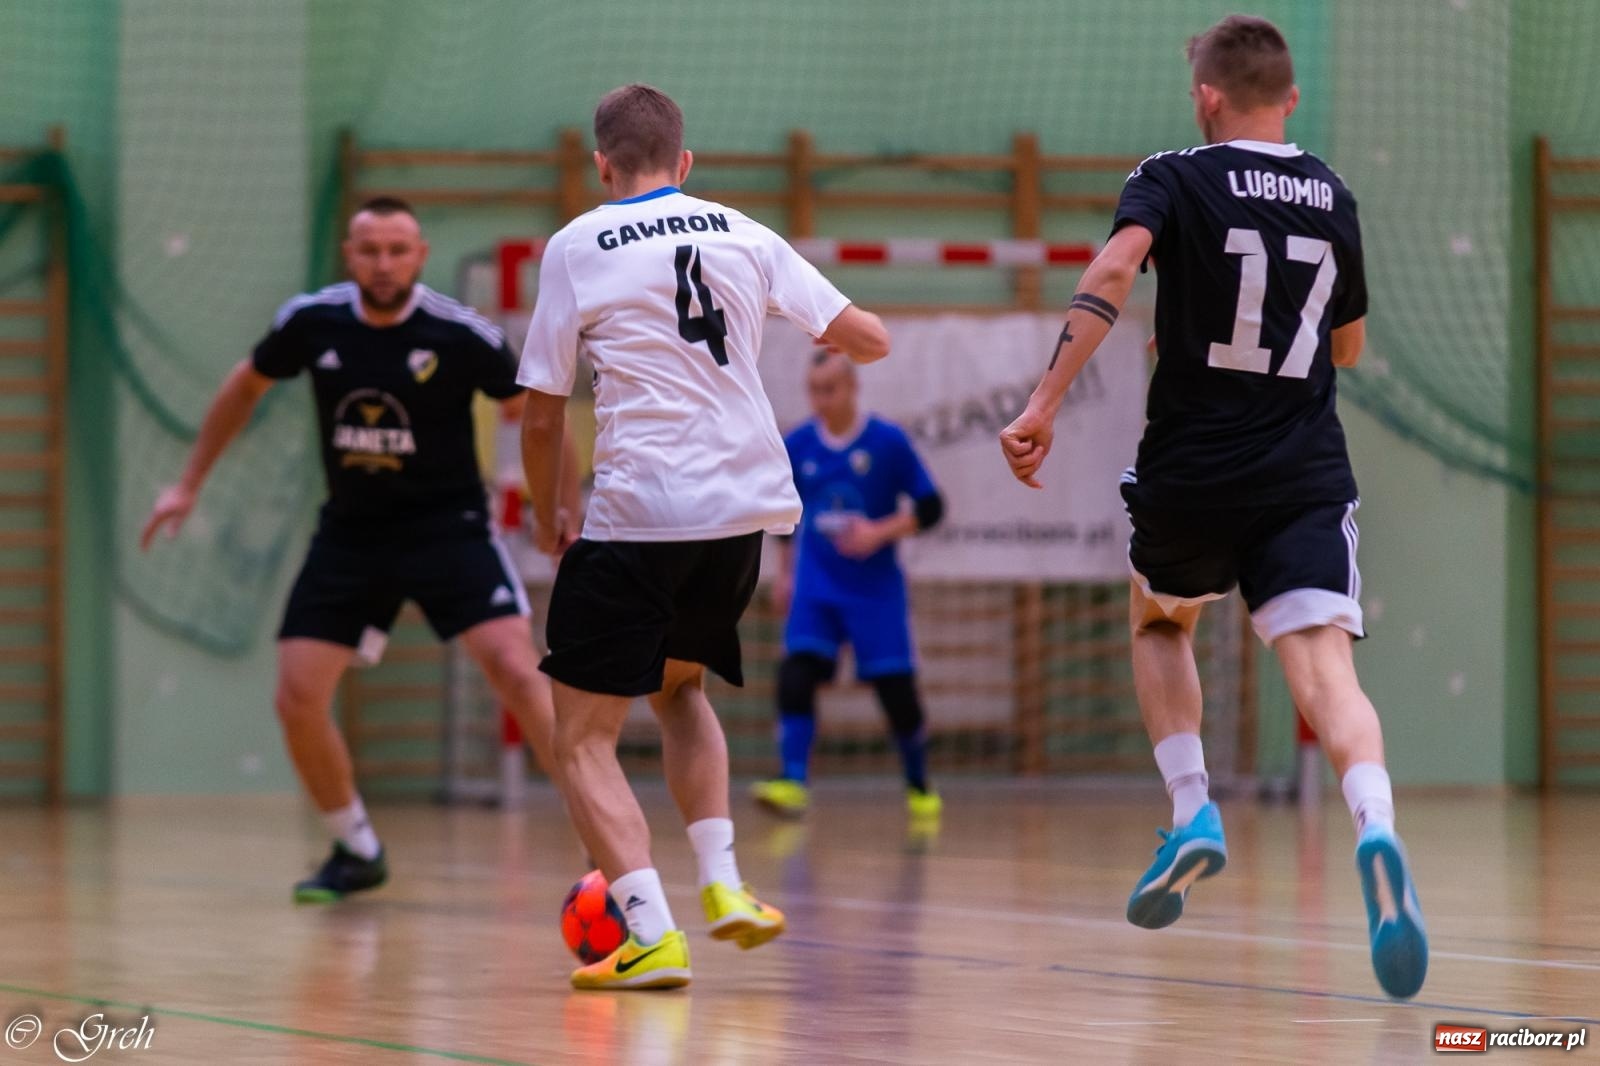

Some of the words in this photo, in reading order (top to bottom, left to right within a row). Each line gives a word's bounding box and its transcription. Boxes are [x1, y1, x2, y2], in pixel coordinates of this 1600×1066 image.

[597, 212, 731, 252] GAWRON
[1227, 169, 1335, 212] LUBOMIA
[674, 244, 730, 368] 4
[1207, 227, 1338, 380] 17
